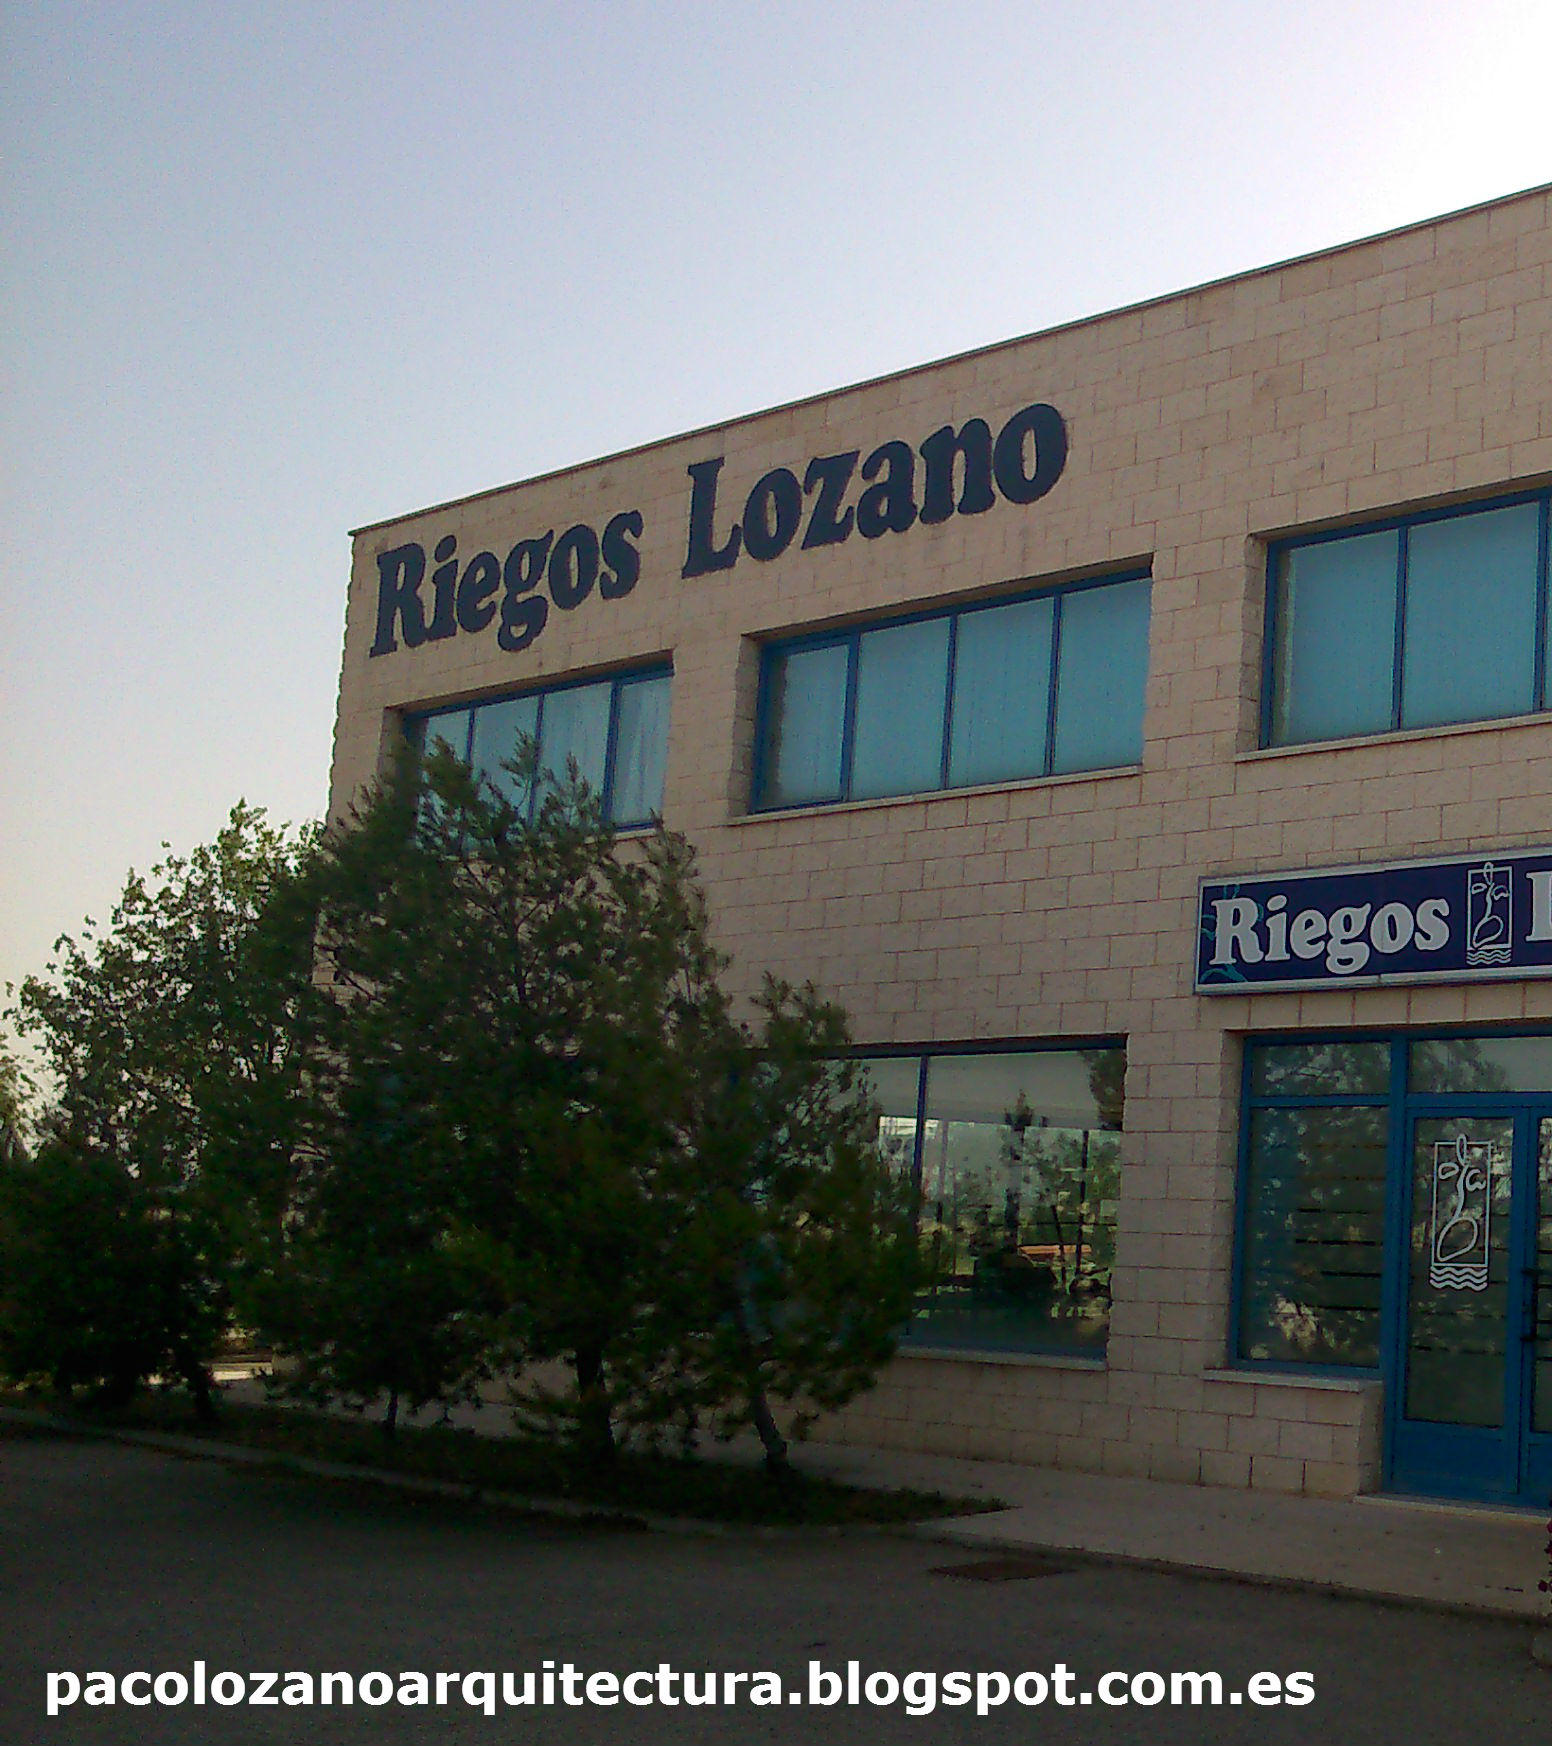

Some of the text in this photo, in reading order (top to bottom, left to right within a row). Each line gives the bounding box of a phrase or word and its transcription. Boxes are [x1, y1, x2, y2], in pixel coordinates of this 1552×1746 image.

[369, 402, 1070, 657] Riegos Lozano
[1209, 894, 1450, 973] Riegos
